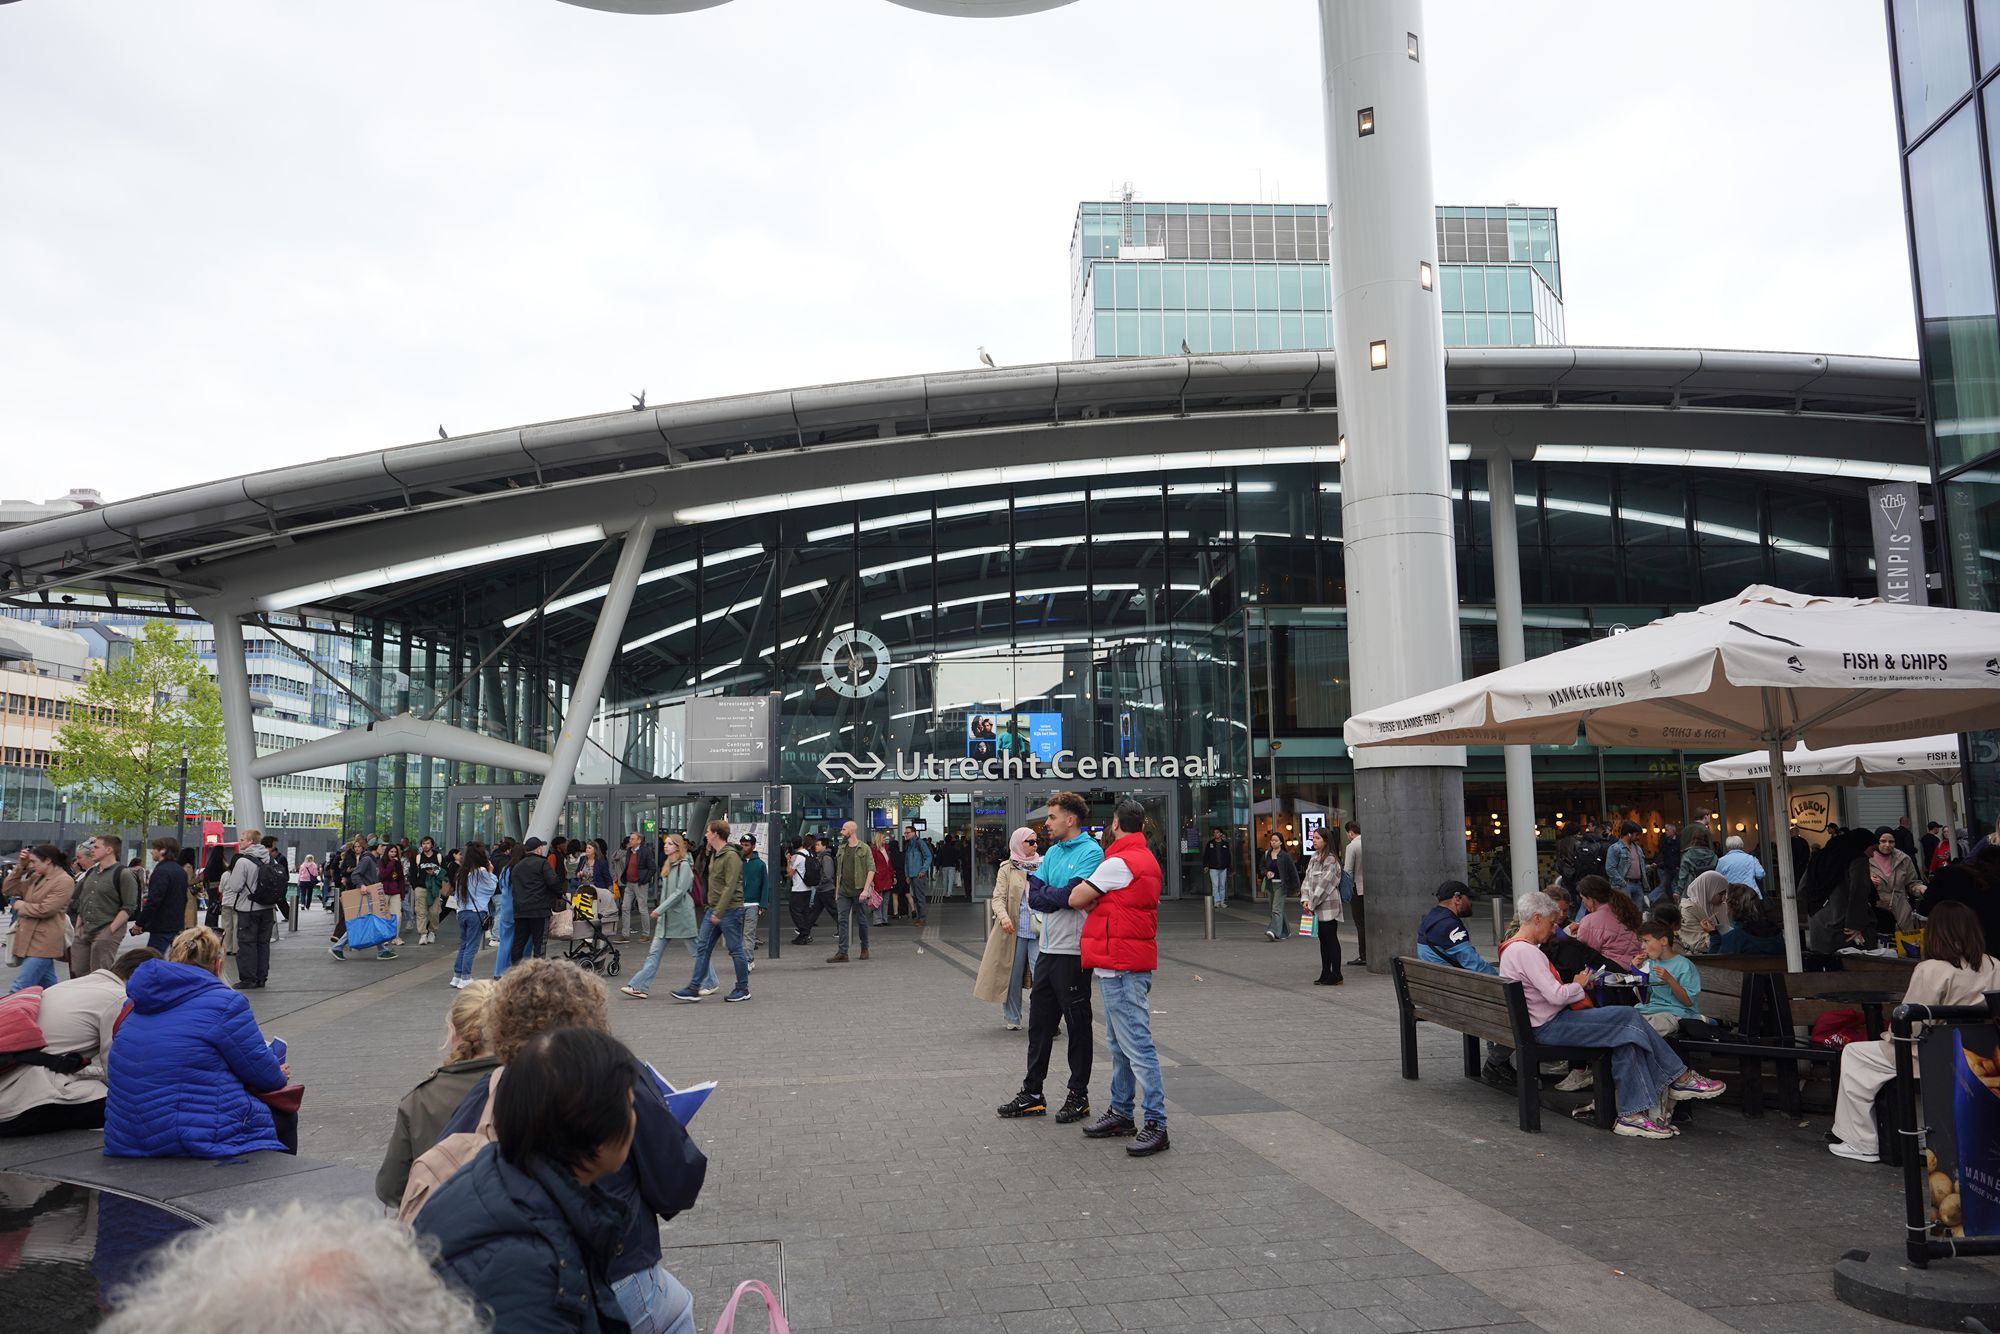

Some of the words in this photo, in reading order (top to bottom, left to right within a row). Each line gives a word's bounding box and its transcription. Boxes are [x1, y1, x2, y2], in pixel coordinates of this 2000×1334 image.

[1842, 653, 1879, 670] FISH
[1885, 653, 1896, 670] &
[1901, 653, 1948, 671] CHIPS
[1548, 681, 1625, 709] MANNEKENPIS
[1379, 721, 1395, 733] VERSE
[1395, 715, 1424, 731] VLAAMSE
[1422, 712, 1441, 726] FRIET
[896, 748, 1041, 781] Utrecht
[1051, 746, 1215, 780] Centraal
[1926, 752, 1947, 761] FISH
[1950, 751, 1957, 760] &
[1747, 764, 1801, 776] MANNNPIS
[1794, 800, 1826, 816] LEBKOV
